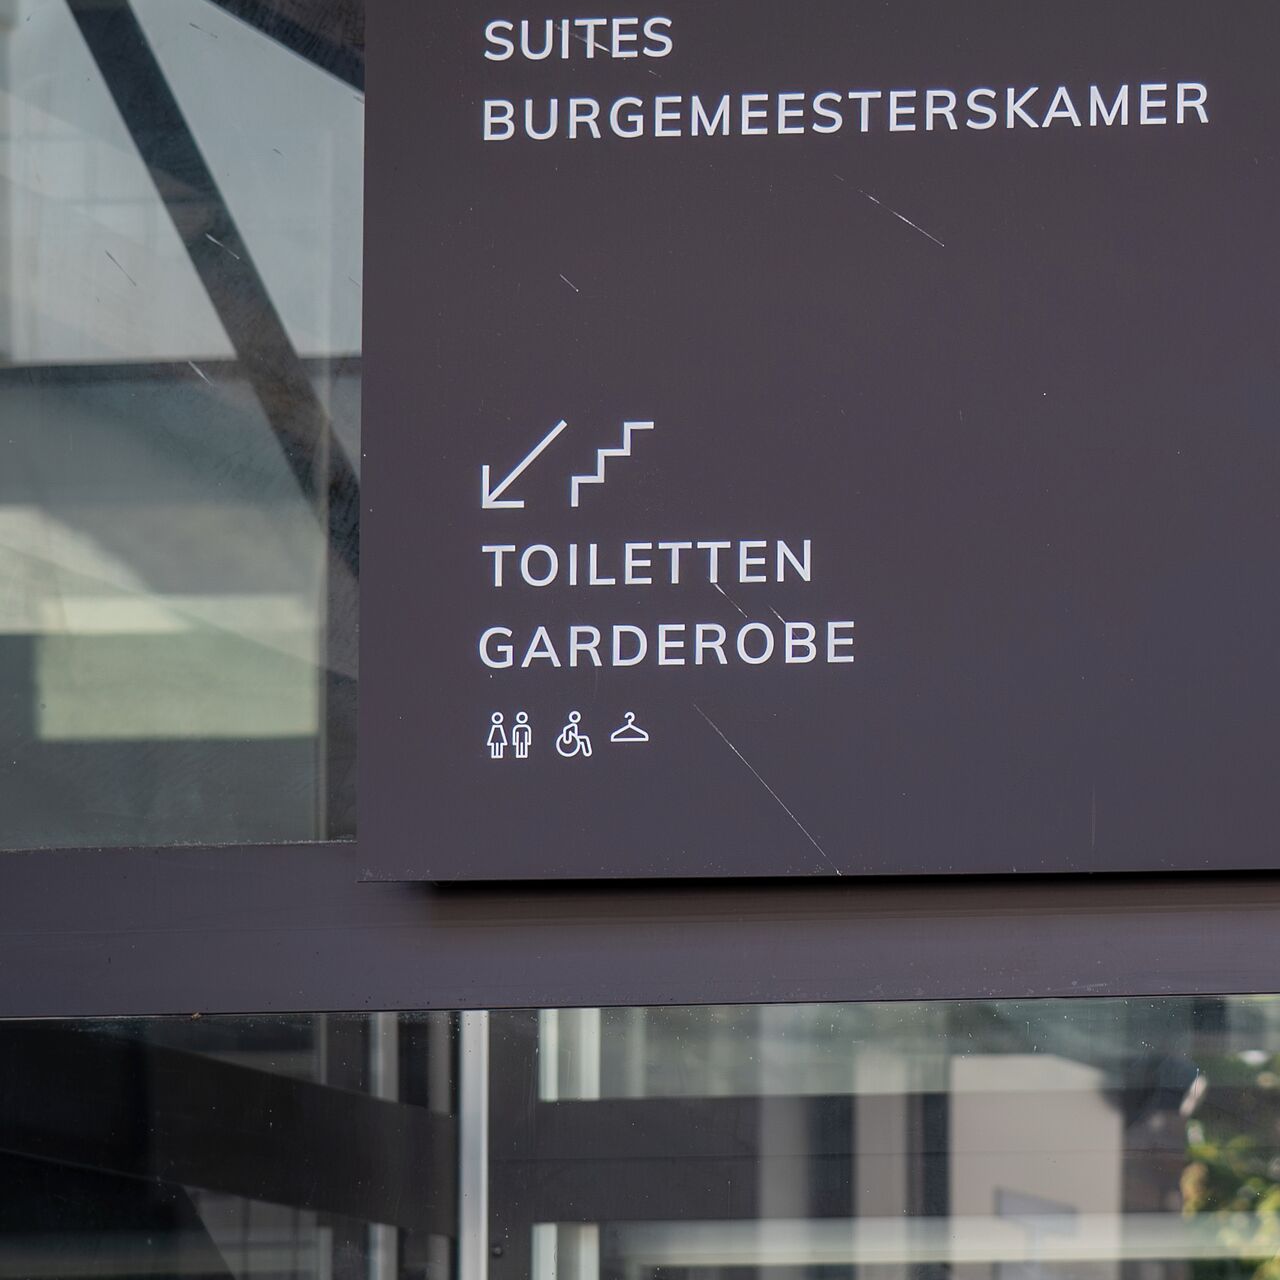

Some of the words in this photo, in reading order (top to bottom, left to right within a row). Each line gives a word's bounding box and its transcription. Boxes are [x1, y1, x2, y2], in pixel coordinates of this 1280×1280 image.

[484, 17, 673, 61] SUITES
[483, 82, 1209, 141] BURGEMEESTERSKAMER
[481, 538, 812, 587] TOILETTEN
[479, 620, 855, 669] GARDEROBE
